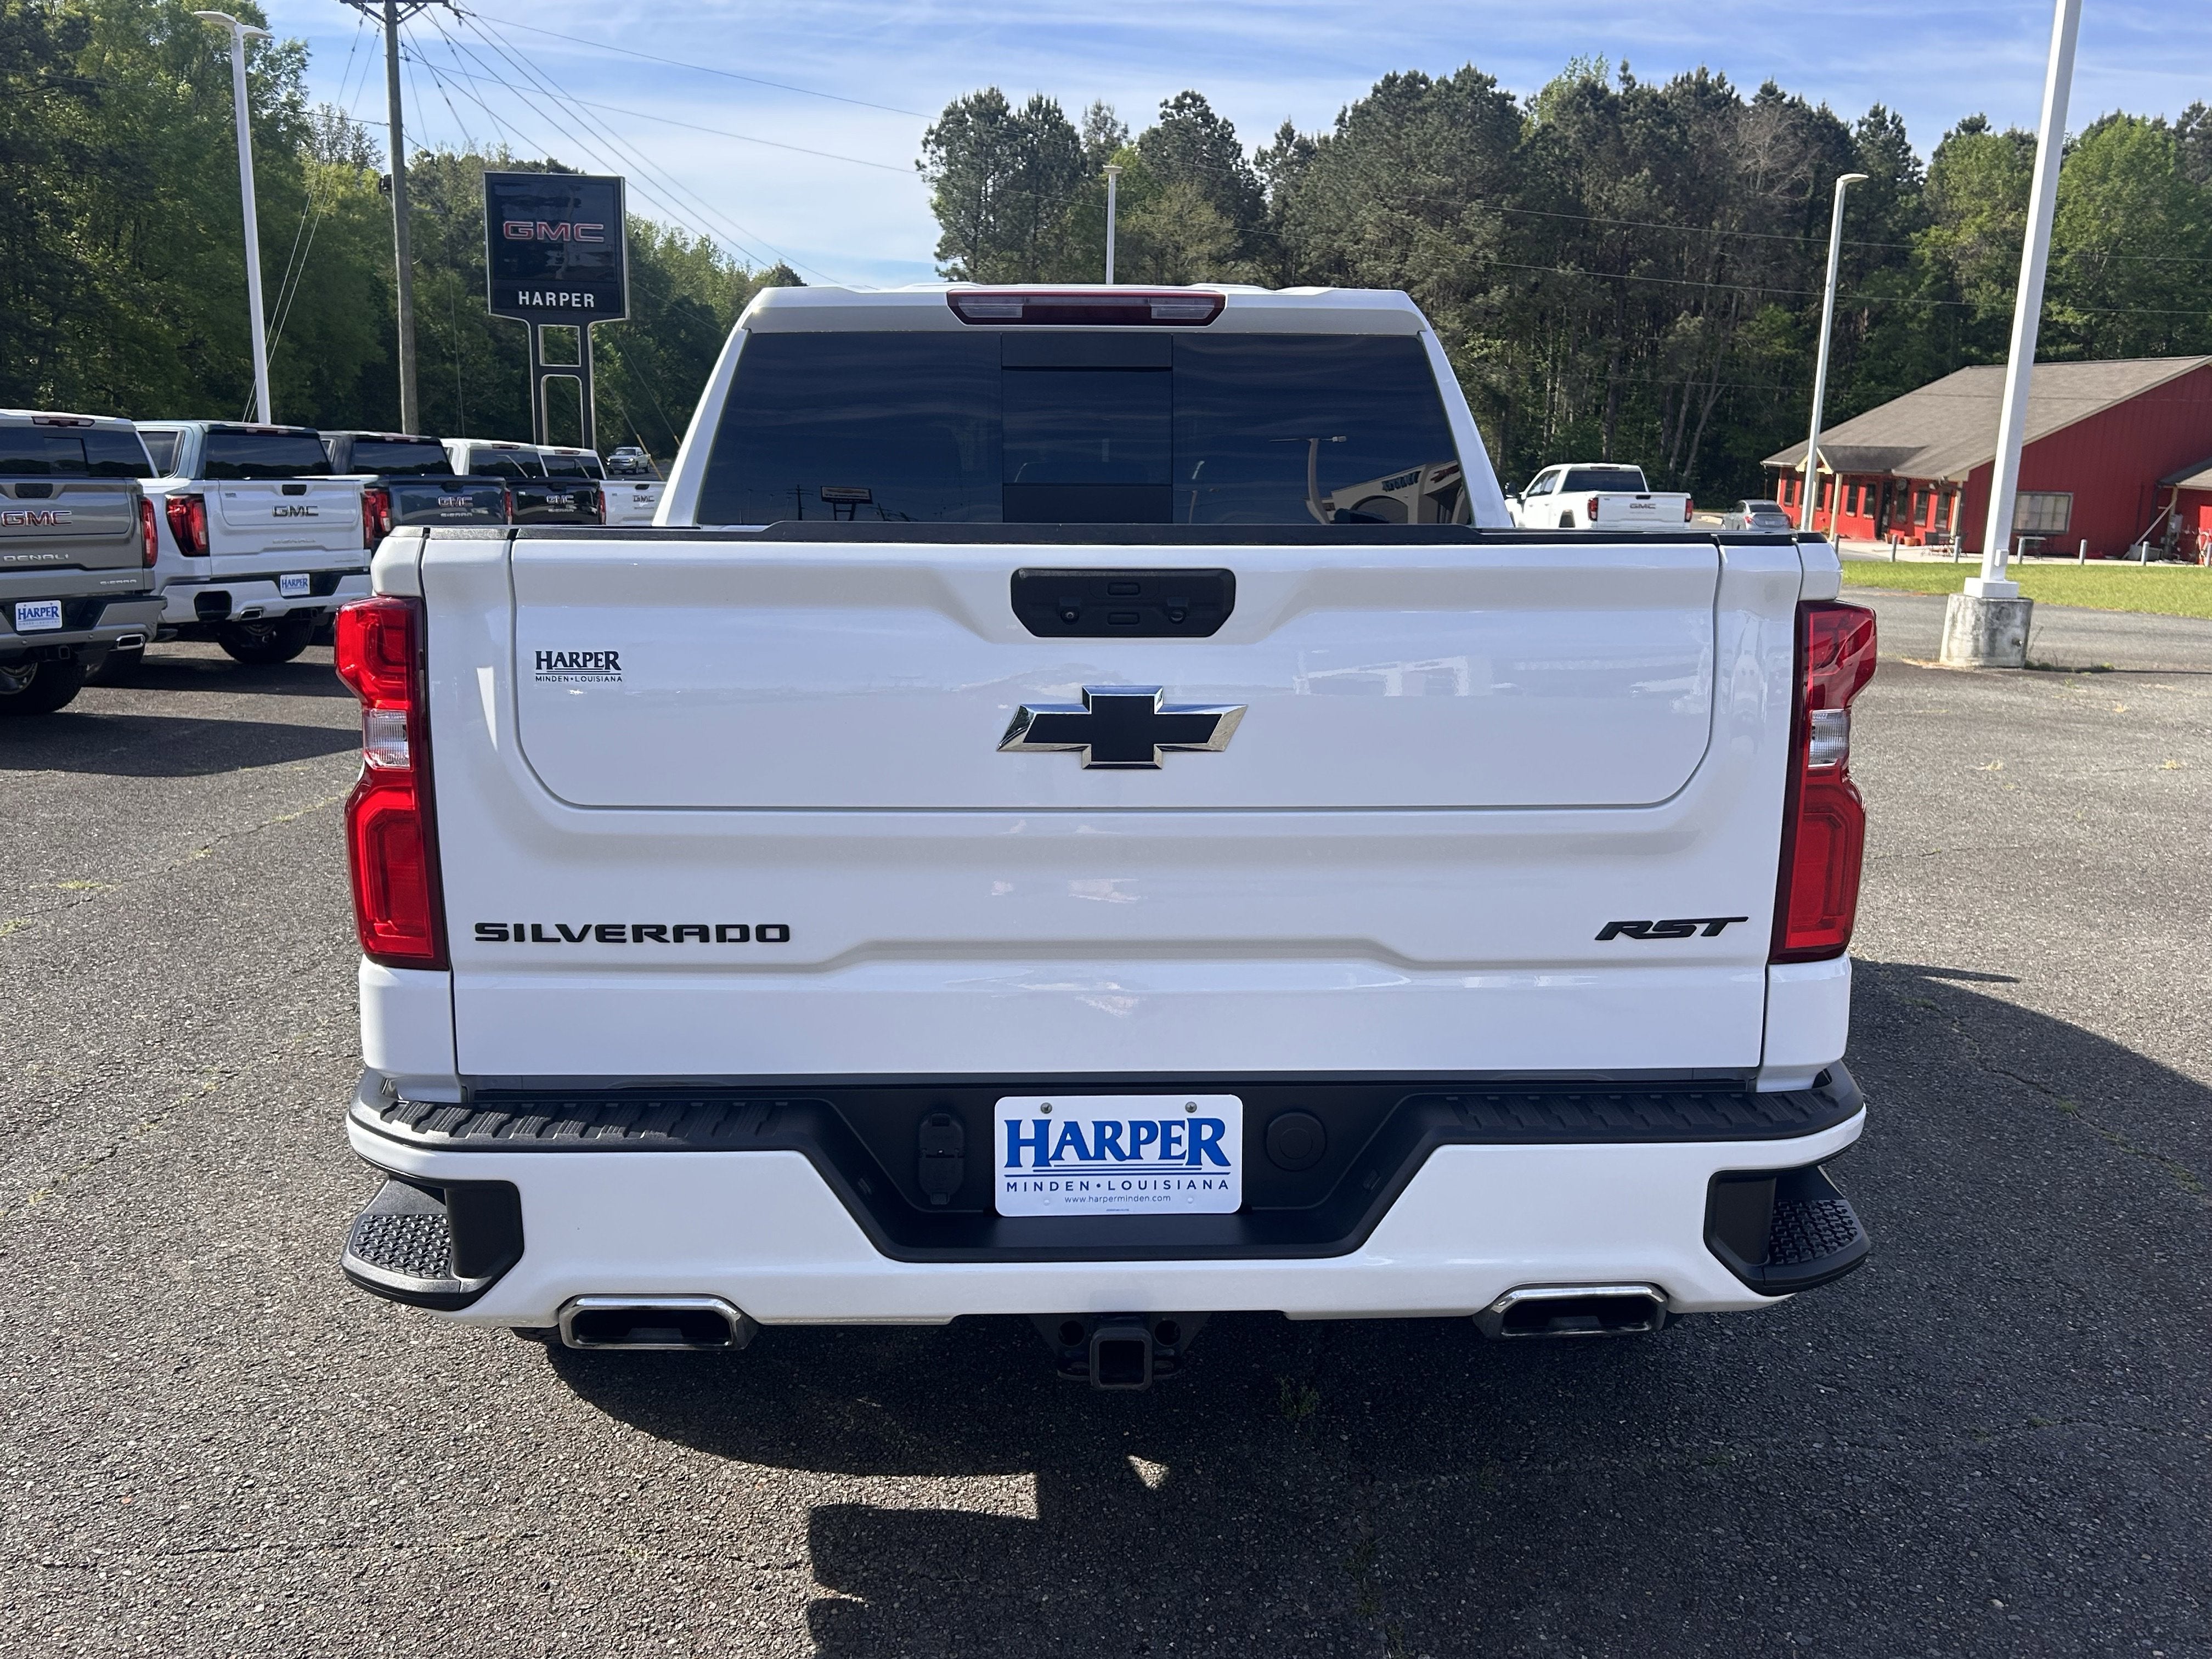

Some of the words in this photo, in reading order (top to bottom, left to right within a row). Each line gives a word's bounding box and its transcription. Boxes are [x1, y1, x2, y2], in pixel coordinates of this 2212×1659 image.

[503, 221, 604, 242] GMC
[518, 291, 594, 308] HARPER
[1, 510, 72, 527] GMC
[272, 505, 319, 517] GMC
[3, 553, 69, 562] DENALI
[281, 578, 308, 589] HARPER
[18, 606, 60, 620] HARPER
[535, 651, 622, 670] HARPER
[475, 923, 790, 943] SILVERADO
[1594, 916, 1749, 940] RST
[1004, 1118, 1232, 1168] HARPER
[1064, 1194, 1171, 1204] www.harperminden.com
